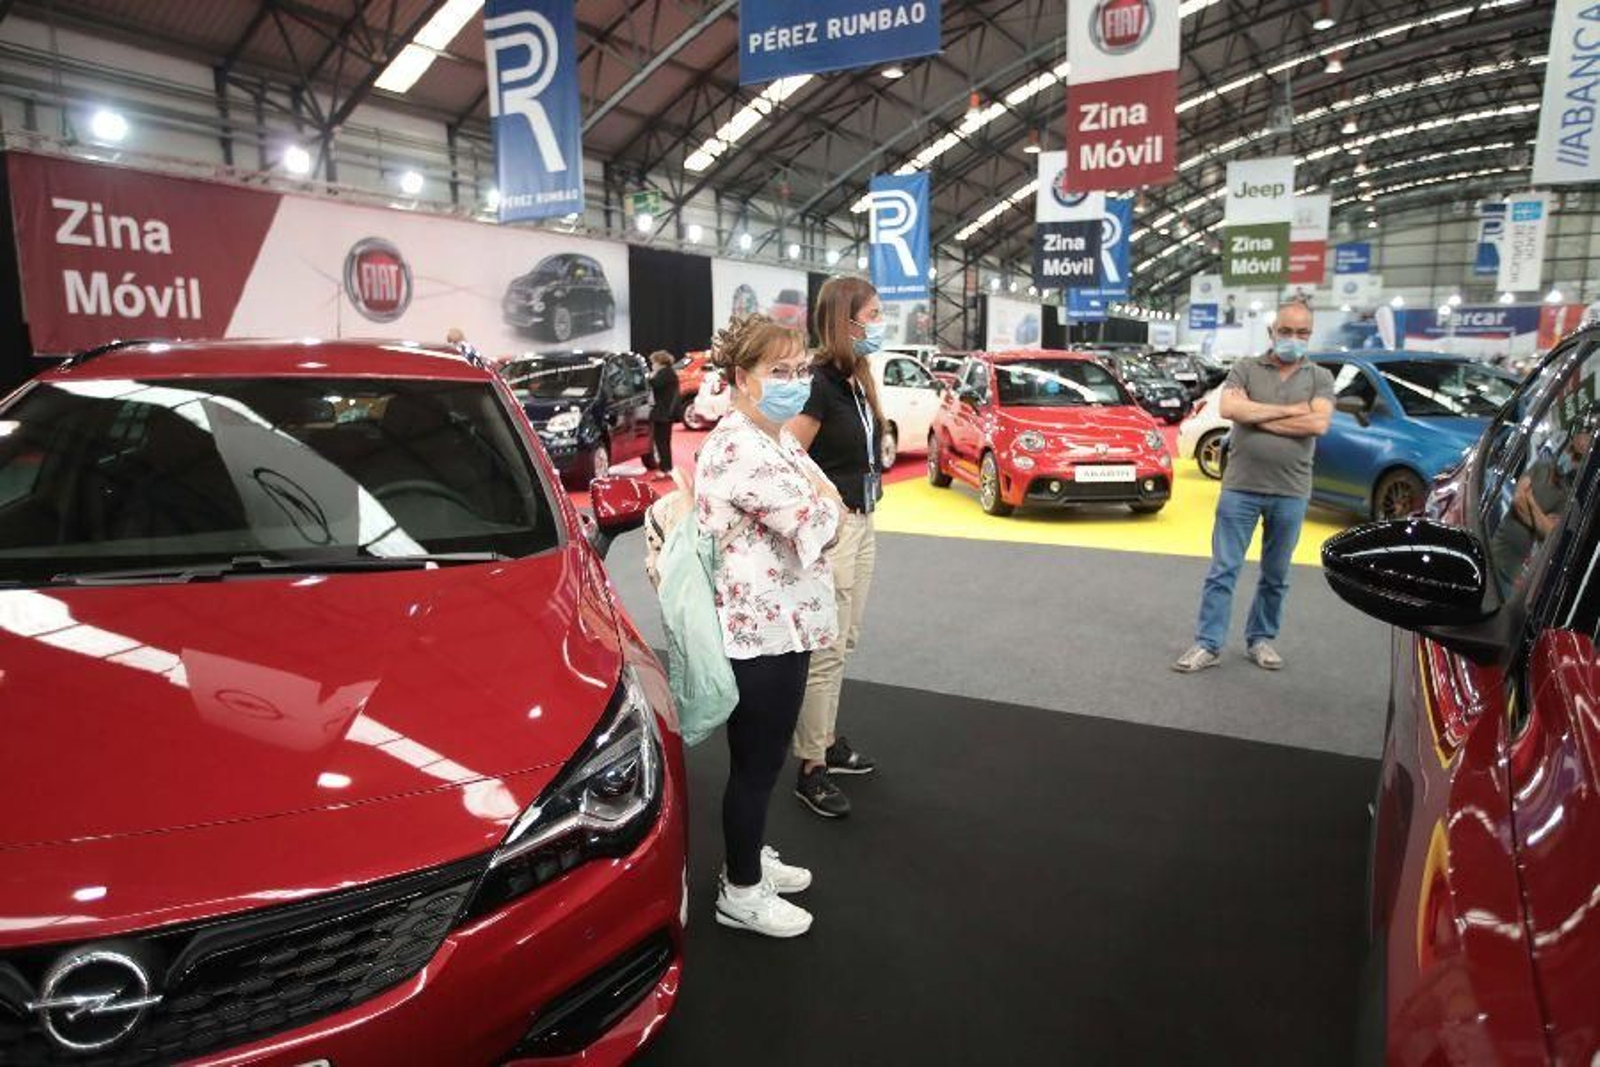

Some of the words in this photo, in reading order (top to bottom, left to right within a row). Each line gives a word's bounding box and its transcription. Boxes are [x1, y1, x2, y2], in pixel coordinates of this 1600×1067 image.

[748, 22, 818, 53] PÉREZ
[827, 3, 925, 39] RUMBAO
[1105, 5, 1142, 38] FIAT
[1079, 102, 1147, 131] Zina
[1080, 135, 1163, 171] Móvil
[1234, 182, 1285, 199] Jeep
[52, 198, 172, 254] Zina
[1043, 234, 1085, 251] Zina
[1231, 236, 1273, 252] Zina
[361, 262, 399, 300] FIAT
[1042, 258, 1094, 276] Móvil
[1231, 257, 1282, 275] Móvil
[63, 269, 202, 319] Móvil
